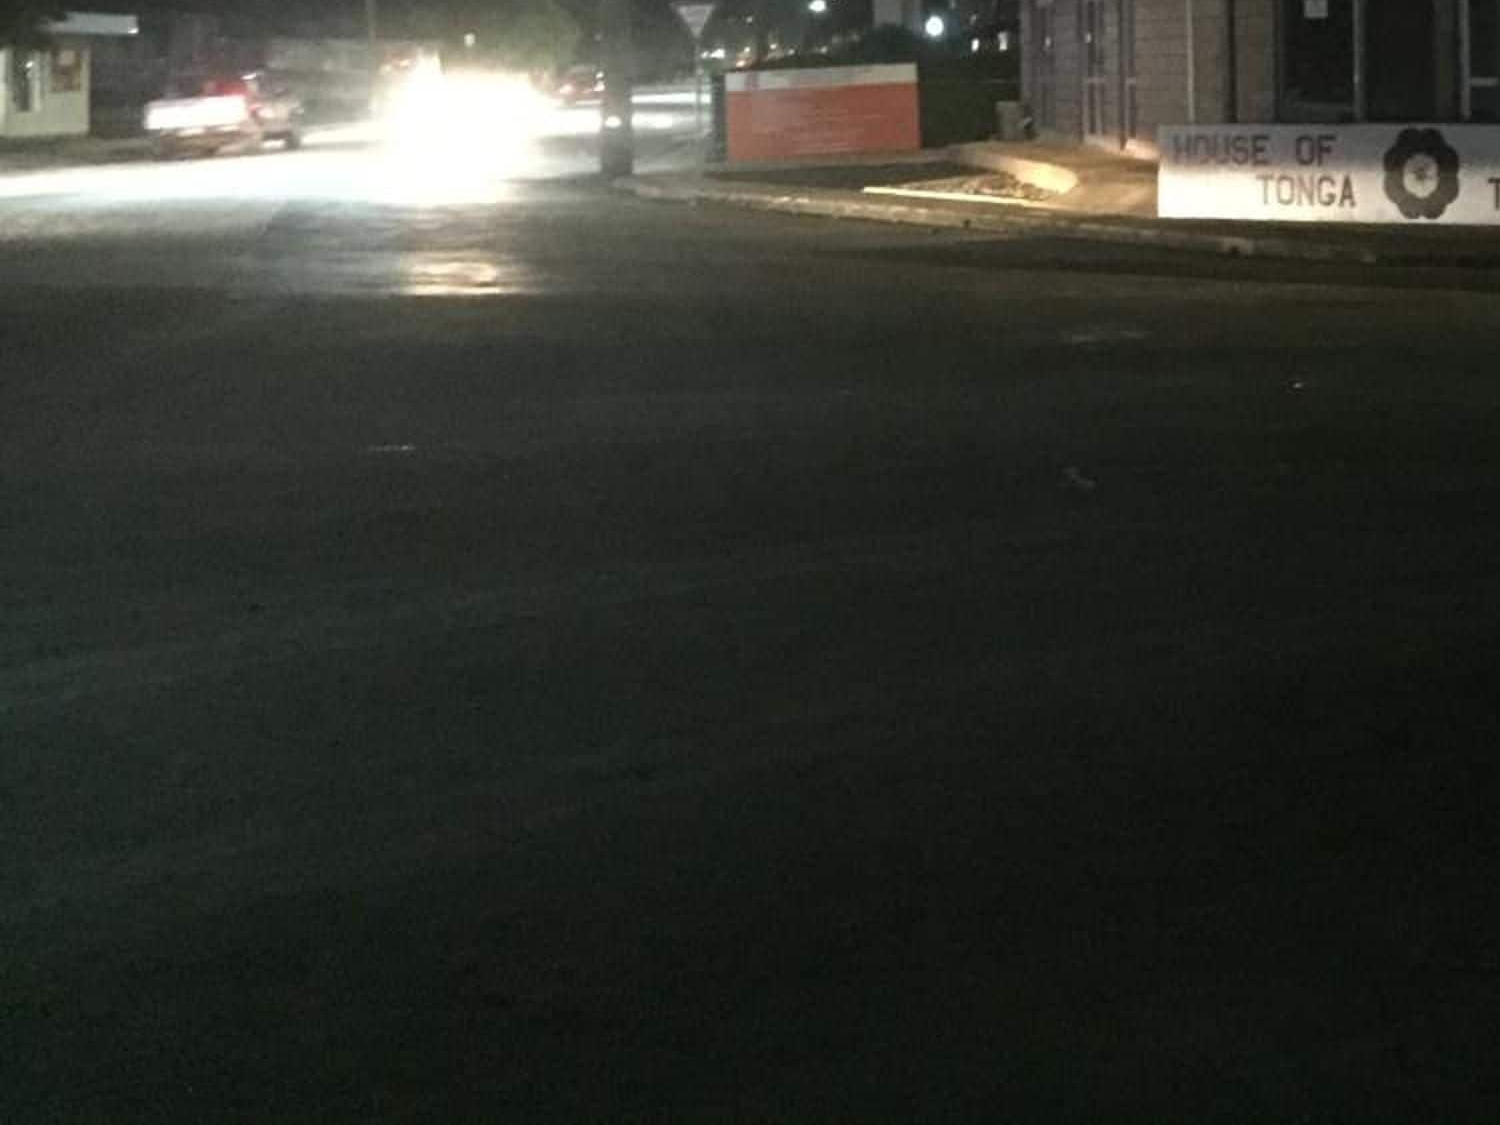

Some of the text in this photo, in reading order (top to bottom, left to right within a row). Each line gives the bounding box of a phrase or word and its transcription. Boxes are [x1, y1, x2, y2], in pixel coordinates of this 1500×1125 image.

[1174, 135, 1337, 166] HOUSE OF
[1258, 175, 1356, 207] TONGA
